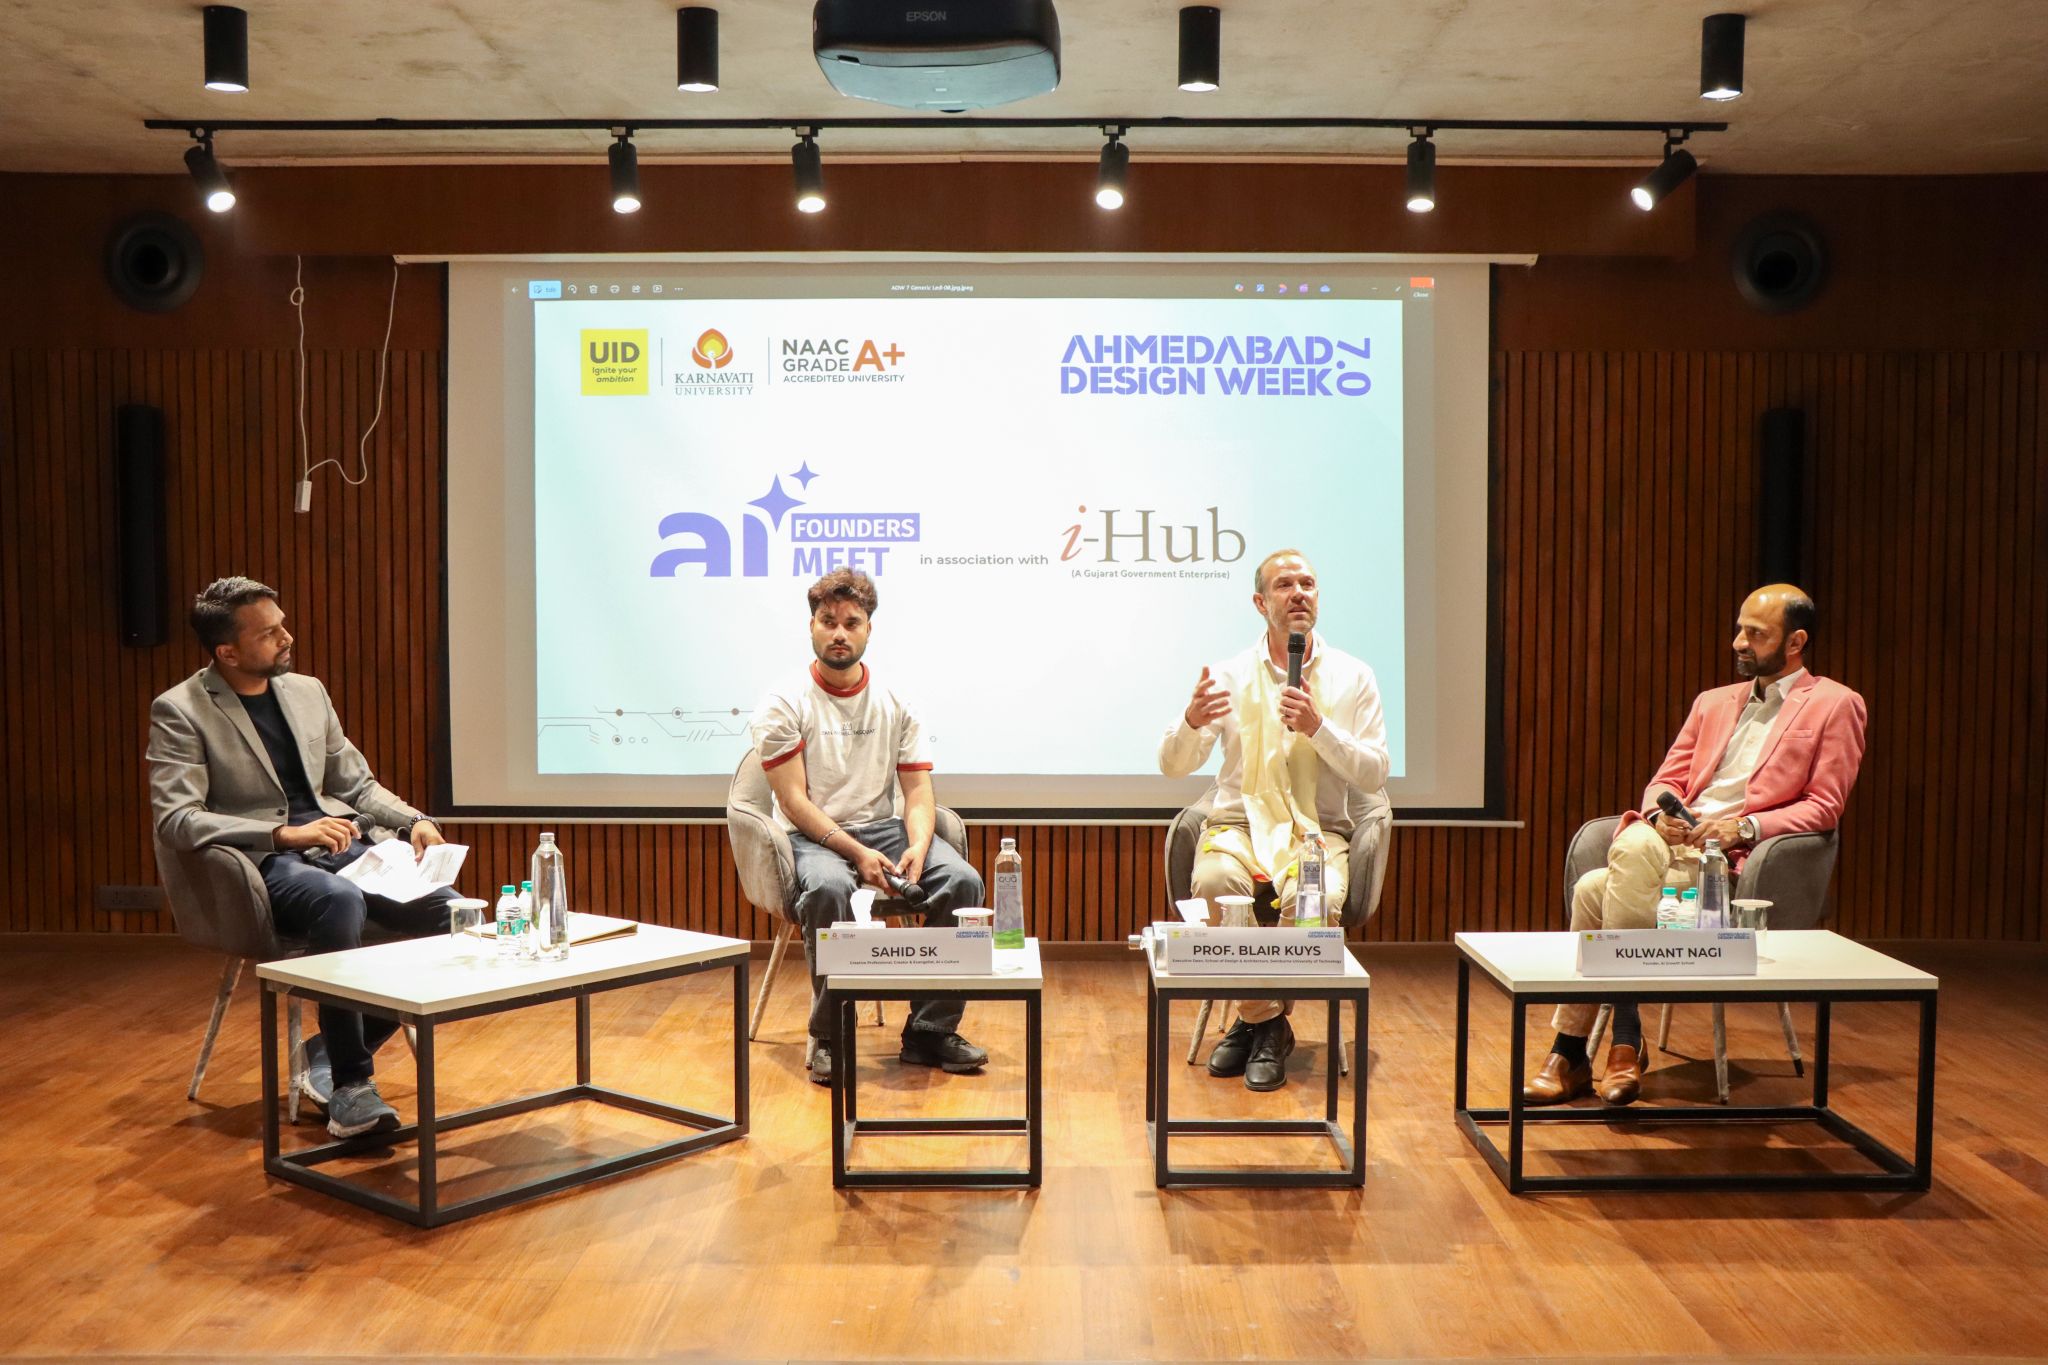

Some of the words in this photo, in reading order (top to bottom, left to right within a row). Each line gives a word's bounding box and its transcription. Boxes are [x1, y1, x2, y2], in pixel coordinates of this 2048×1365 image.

[906, 11, 946, 21] EPSON
[590, 341, 640, 364] UID
[782, 338, 849, 356] NAAC
[1061, 334, 1334, 365] AHMEDABAD
[852, 339, 905, 372] A+
[782, 357, 850, 372] GRADE
[618, 367, 637, 375] your
[596, 375, 634, 383] ambition
[675, 372, 753, 384] KARNAVATI
[783, 374, 845, 383] ACCREDITED
[848, 374, 905, 383] UNIVERSITY
[1214, 367, 1334, 396] WEEK
[675, 386, 753, 396] UNIVERSITY
[794, 518, 916, 539] FOUNDERS
[1060, 505, 1246, 564] i-Hub
[792, 547, 890, 577] MEET
[920, 554, 932, 565] in
[936, 554, 1013, 565] association
[1018, 554, 1049, 565] with
[1071, 569, 1082, 578] (A
[1084, 569, 1118, 579] Gujarat
[1120, 569, 1177, 578] Government
[1179, 570, 1230, 580] Enterprise)
[871, 946, 916, 957] SAHID
[919, 946, 938, 957] SK
[1193, 945, 1235, 956] PROF.
[1239, 945, 1280, 956] BLAIR
[1284, 945, 1321, 956] KUYS
[1615, 948, 1684, 958] KULWANT
[1688, 947, 1722, 957] NAGI
